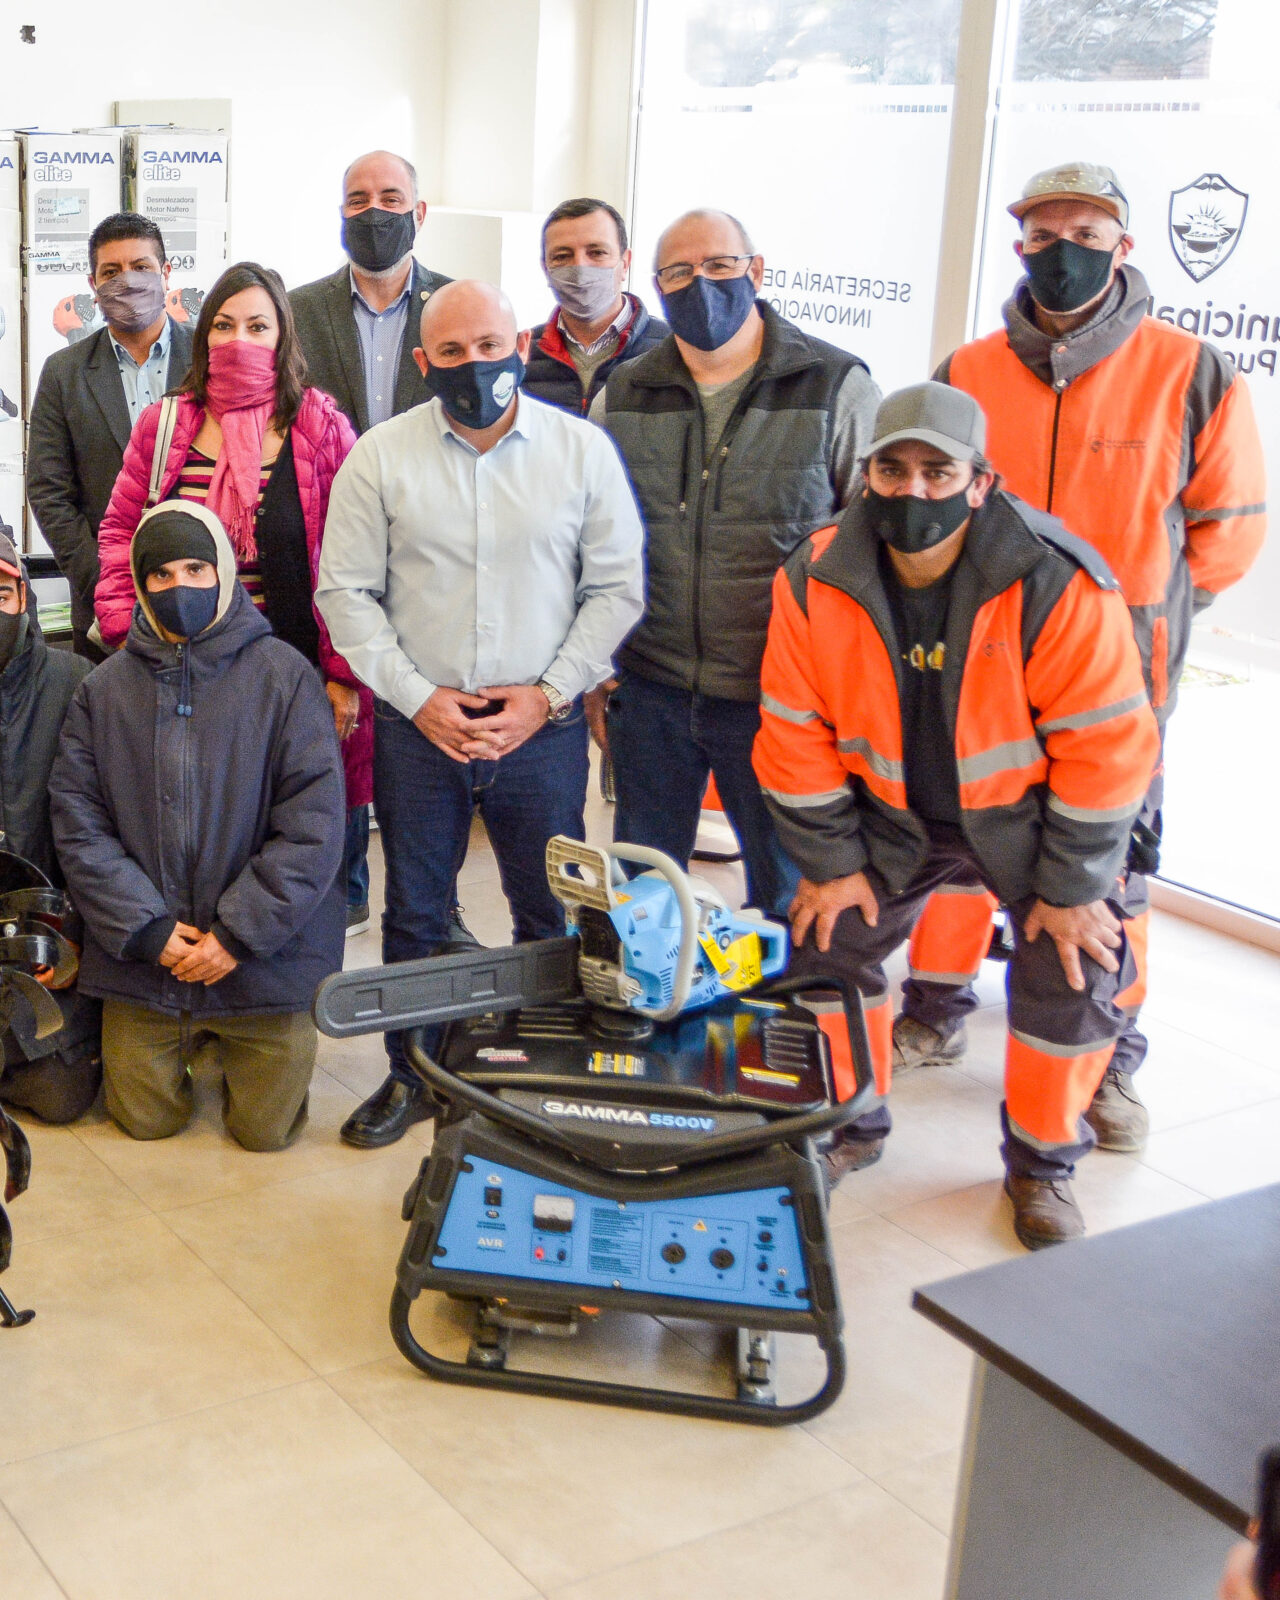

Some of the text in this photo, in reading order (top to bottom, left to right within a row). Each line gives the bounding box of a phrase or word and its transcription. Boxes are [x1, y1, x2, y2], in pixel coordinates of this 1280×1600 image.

[32, 152, 115, 164] GAMMA
[141, 151, 223, 163] GAMMA
[34, 165, 72, 182] elite
[143, 164, 180, 180] elite
[147, 196, 194, 204] Desmalezadora
[28, 251, 61, 259] GAMMA
[543, 1101, 716, 1132] GAMMA 5500V
[477, 1237, 504, 1248] AVR
